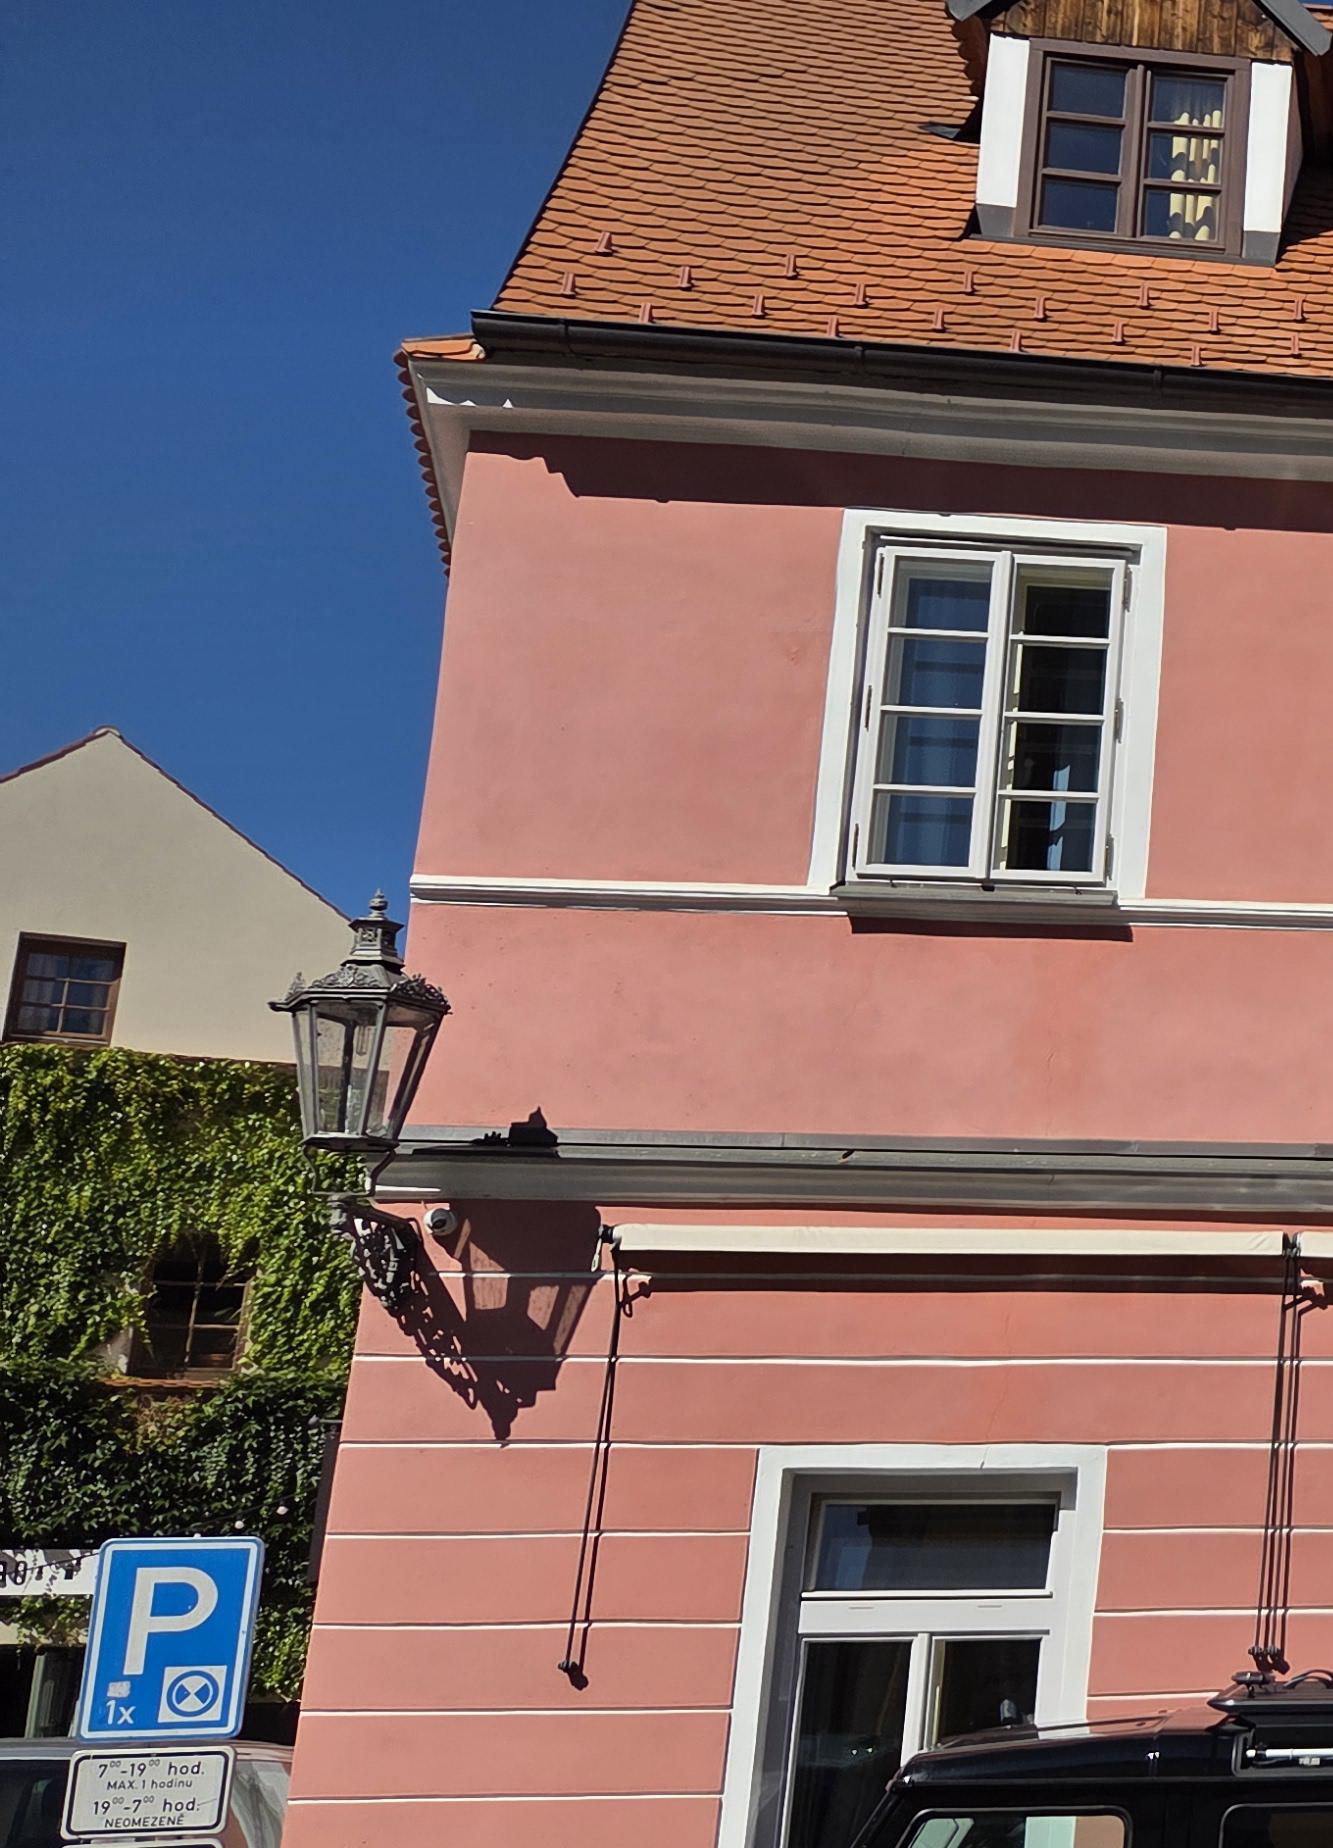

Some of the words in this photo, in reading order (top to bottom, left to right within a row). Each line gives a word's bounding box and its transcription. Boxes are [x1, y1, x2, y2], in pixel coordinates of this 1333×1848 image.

[123, 1566, 218, 1675] P
[106, 1699, 136, 1725] 1x
[168, 1761, 205, 1776] hod.
[107, 1780, 138, 1790] MAX.
[141, 1779, 146, 1789] 1
[150, 1778, 193, 1789] hodinu
[162, 1798, 200, 1812] hod.
[104, 1814, 185, 1828] NEOMEZENĚ
